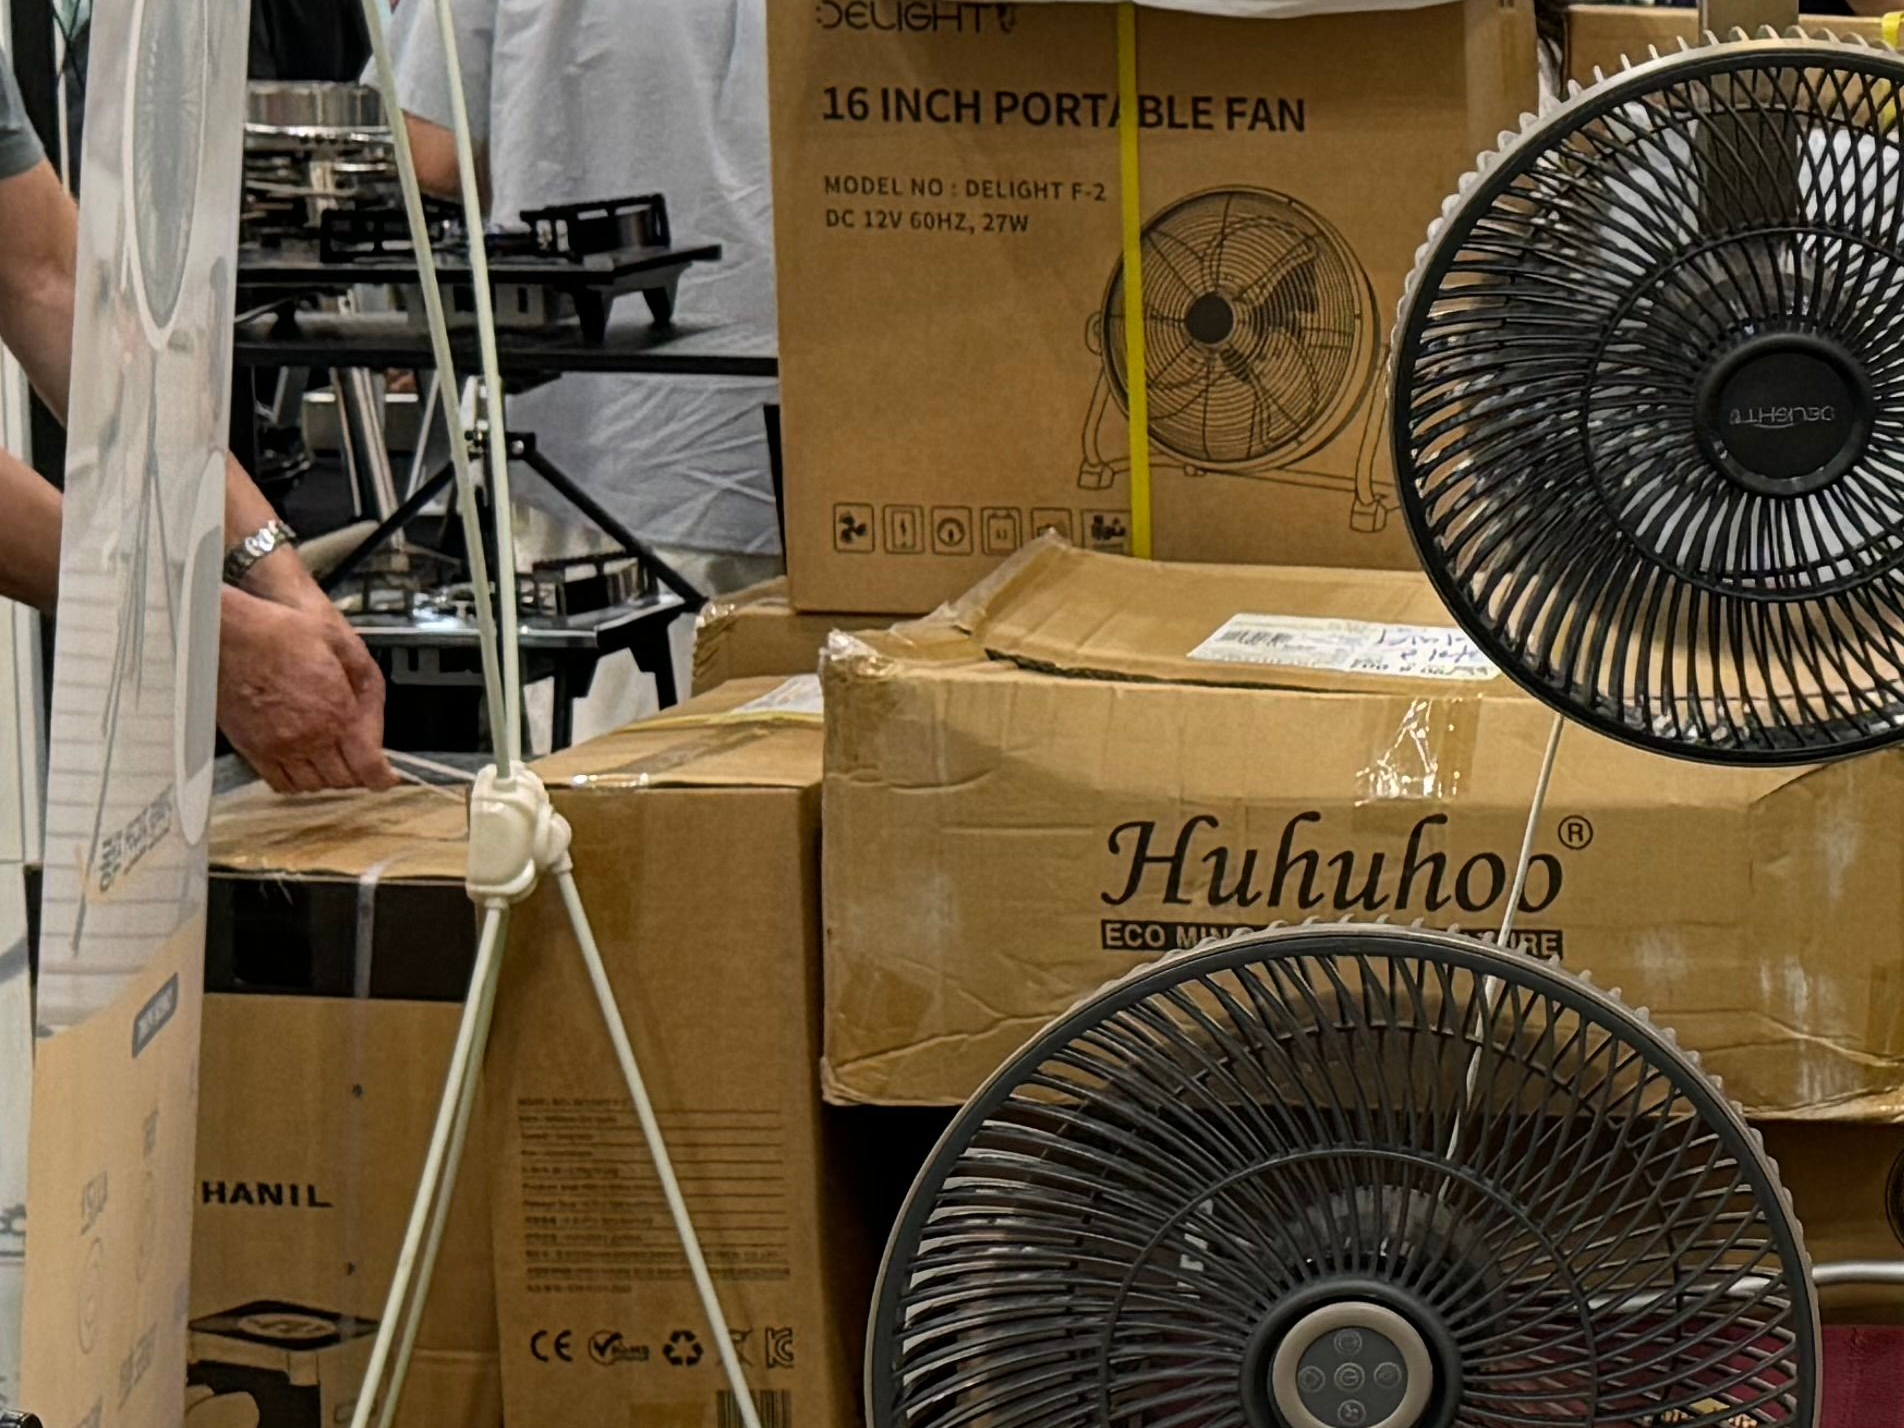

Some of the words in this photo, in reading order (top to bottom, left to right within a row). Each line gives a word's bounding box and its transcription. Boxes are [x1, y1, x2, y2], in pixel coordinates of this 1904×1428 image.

[822, 86, 869, 123] 16
[881, 88, 981, 124] INCH
[1225, 96, 1306, 132] FAN
[824, 175, 904, 197] MODEL
[911, 178, 943, 197] NO
[966, 178, 1063, 201] DELIGHT
[1071, 181, 1107, 201] F-2
[826, 209, 855, 228] DC
[863, 210, 903, 230] 12V
[983, 213, 1029, 234] 27W
[1101, 811, 1565, 913] Huhuhoo
[1104, 923, 1166, 947] ECO
[201, 1181, 333, 1209] HANIL
[530, 1329, 573, 1363] CE
